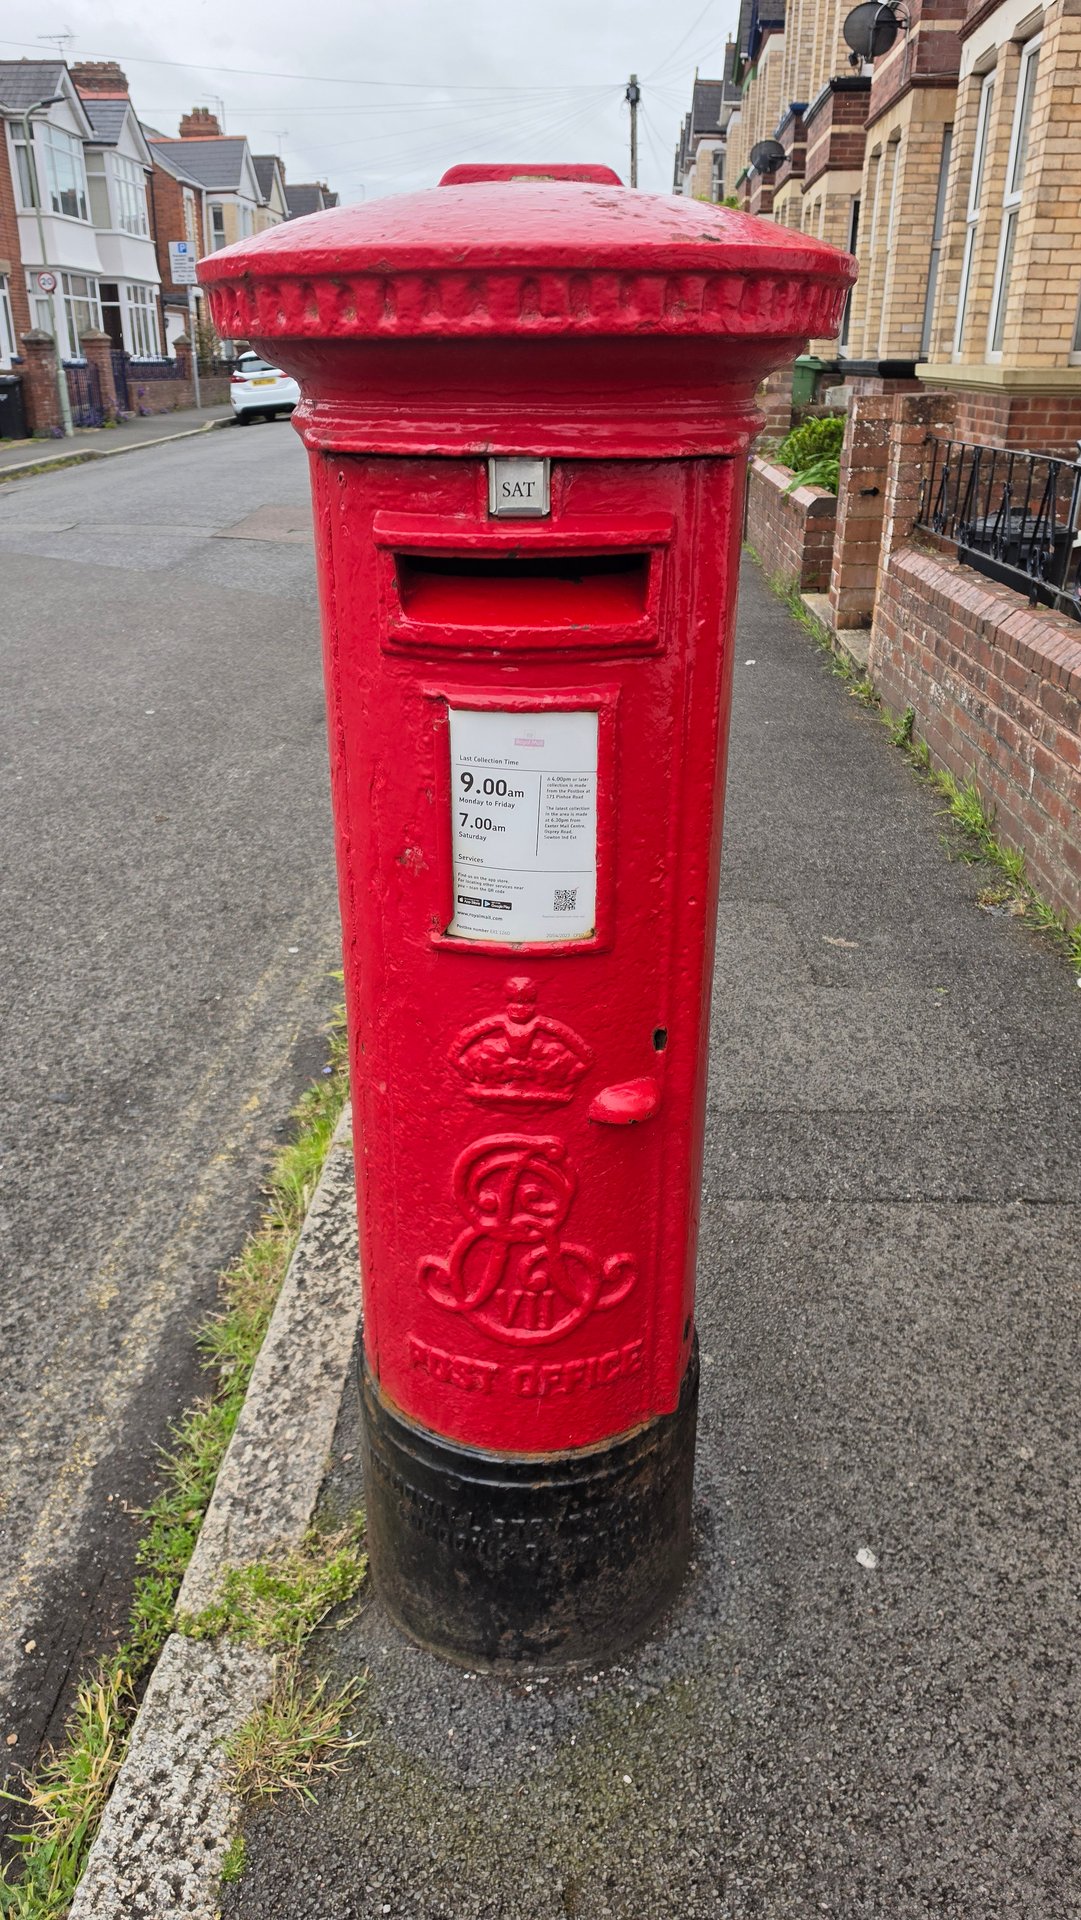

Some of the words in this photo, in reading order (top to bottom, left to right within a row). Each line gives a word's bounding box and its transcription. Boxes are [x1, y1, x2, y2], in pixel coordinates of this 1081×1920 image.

[41, 278, 52, 286] 20
[502, 481, 535, 497] SAT
[474, 756, 503, 764] Collection
[460, 772, 524, 798] 9.00am
[459, 797, 484, 807] Monday
[495, 801, 515, 809] Friday
[459, 812, 506, 832] 7.00am
[459, 831, 487, 841] Saturday
[458, 854, 484, 863] Services
[457, 911, 503, 920] www.royalmail.com
[408, 1335, 498, 1394] POST
[511, 1338, 642, 1397] OFFICE
